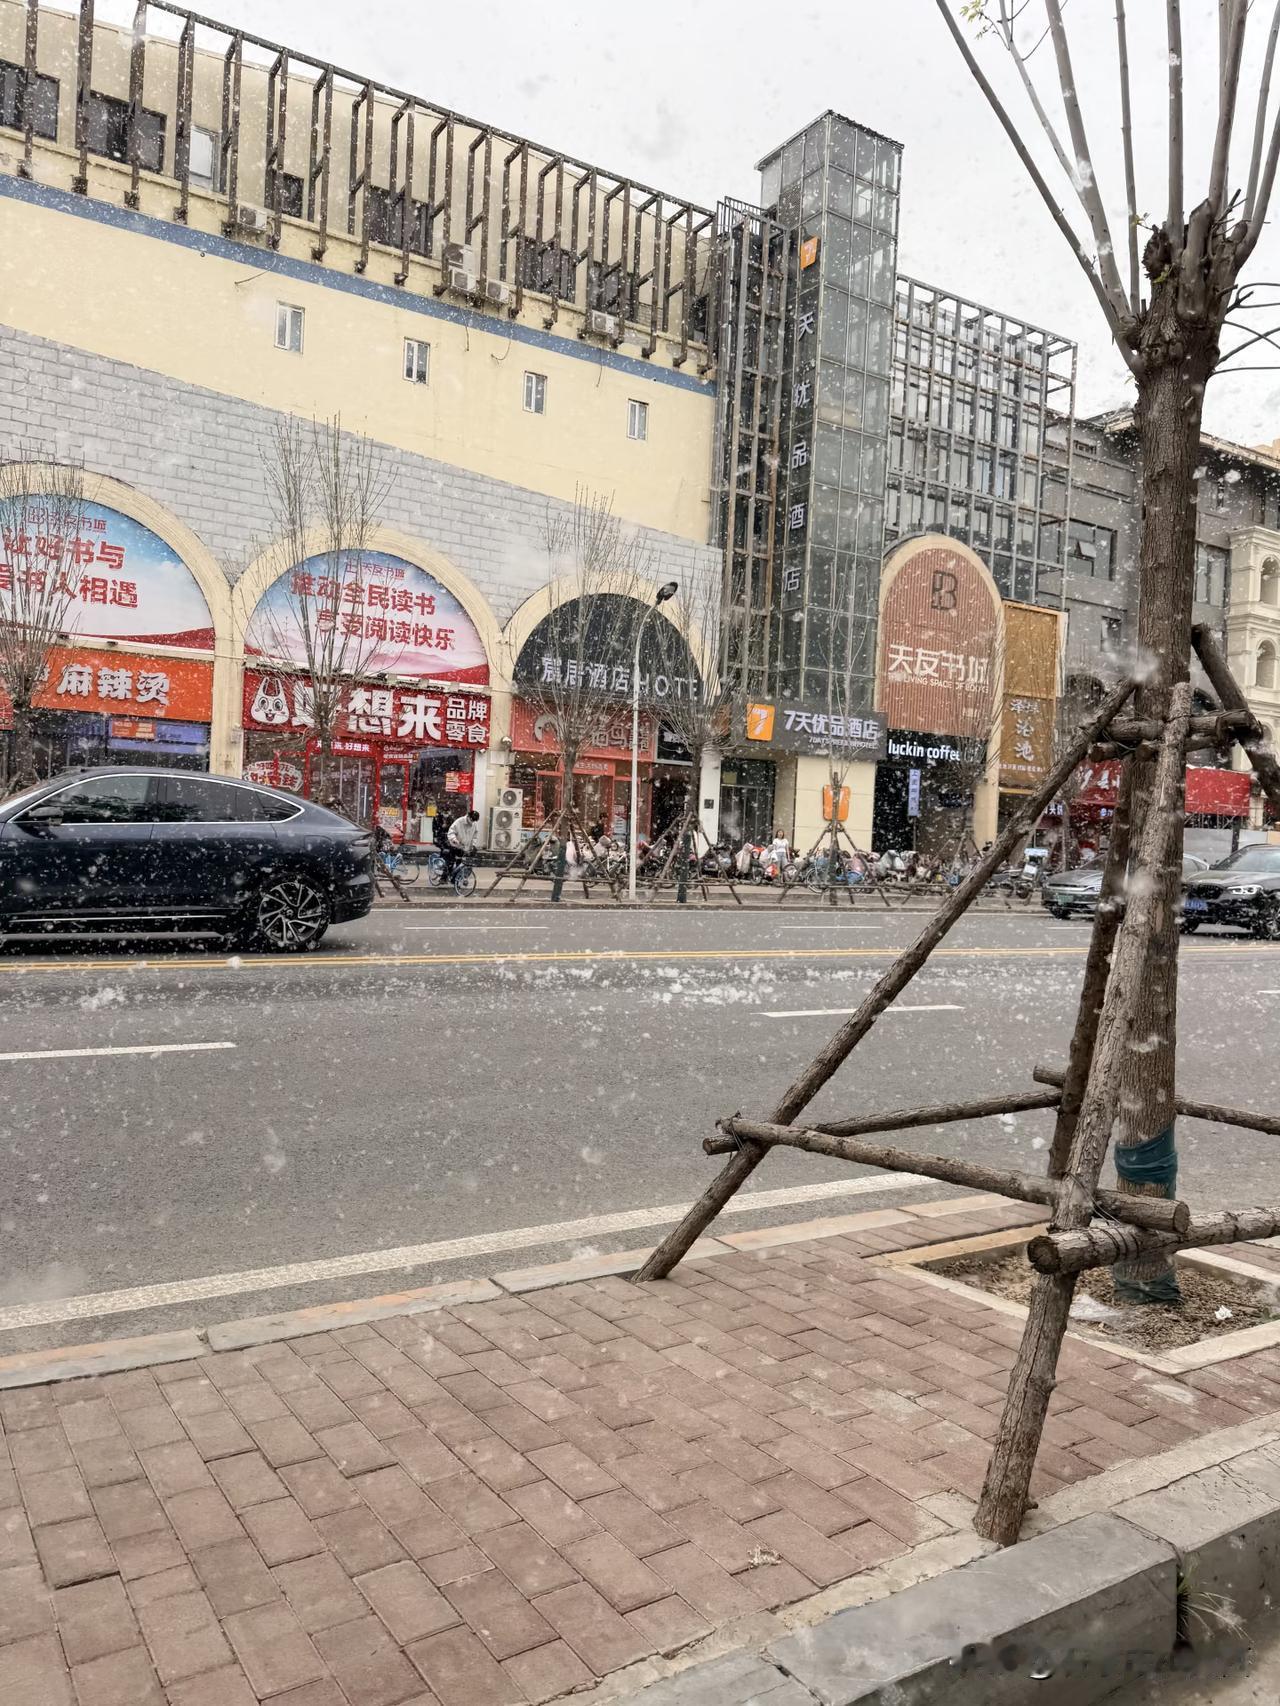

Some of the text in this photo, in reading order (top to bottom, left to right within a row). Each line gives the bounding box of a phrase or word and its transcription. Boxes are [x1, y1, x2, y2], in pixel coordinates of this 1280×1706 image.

[3, 527, 126, 569] 让好书与
[290, 570, 436, 616] 推动全民读书
[888, 643, 989, 685] 天友书城
[56, 663, 170, 706] 麻辣烫
[446, 697, 488, 722] 品牌
[784, 710, 880, 742] 7天优品酒店
[445, 720, 488, 744] 零食
[888, 739, 961, 761] luckin coffee
